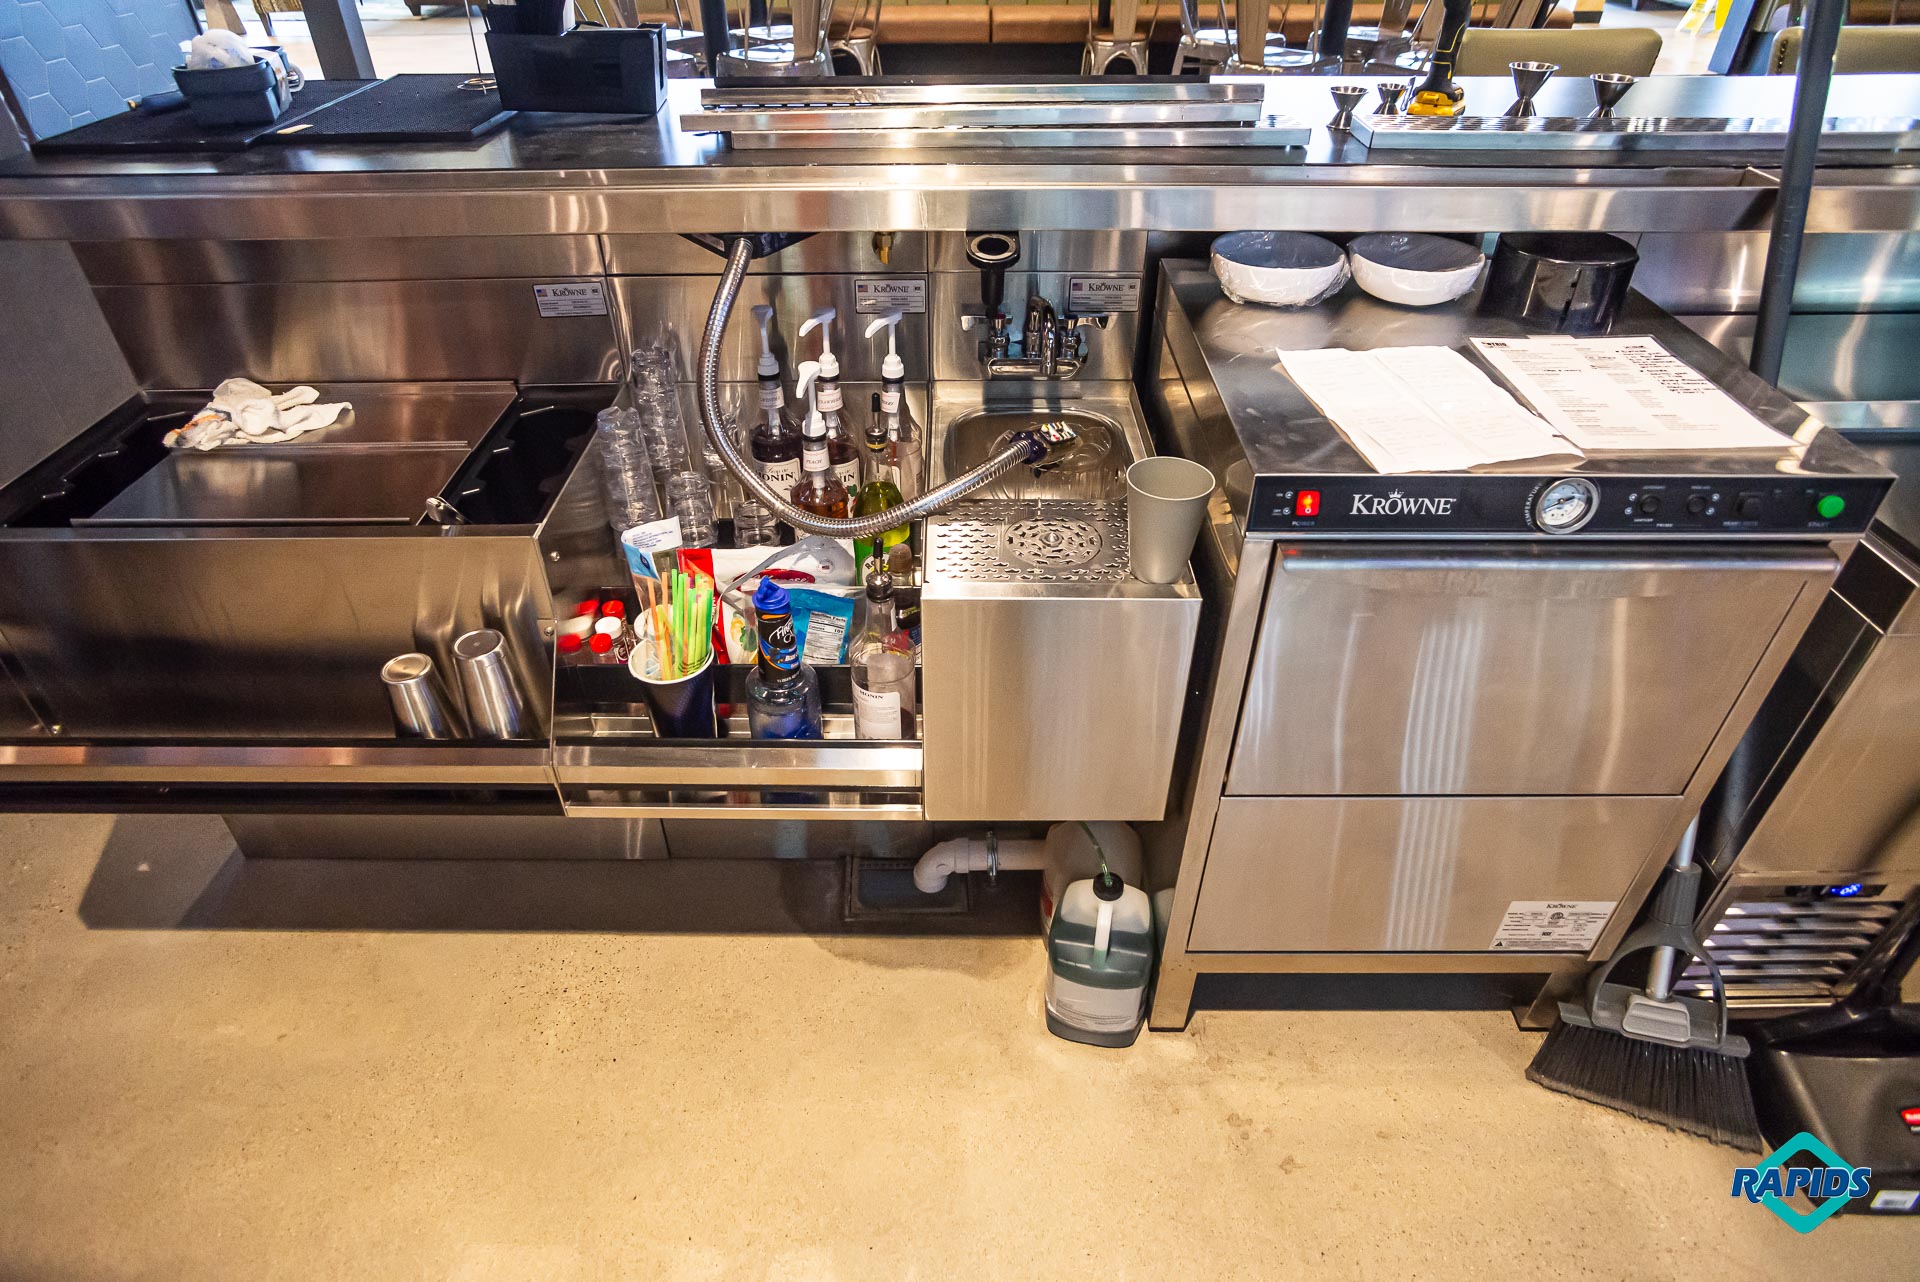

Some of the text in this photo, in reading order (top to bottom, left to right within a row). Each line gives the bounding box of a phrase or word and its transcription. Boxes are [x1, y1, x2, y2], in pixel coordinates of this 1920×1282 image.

[873, 285, 909, 293] KROWNE
[1088, 282, 1124, 292] KROWNE
[552, 288, 587, 297] KROWNE
[1349, 494, 1453, 515] KROWNE
